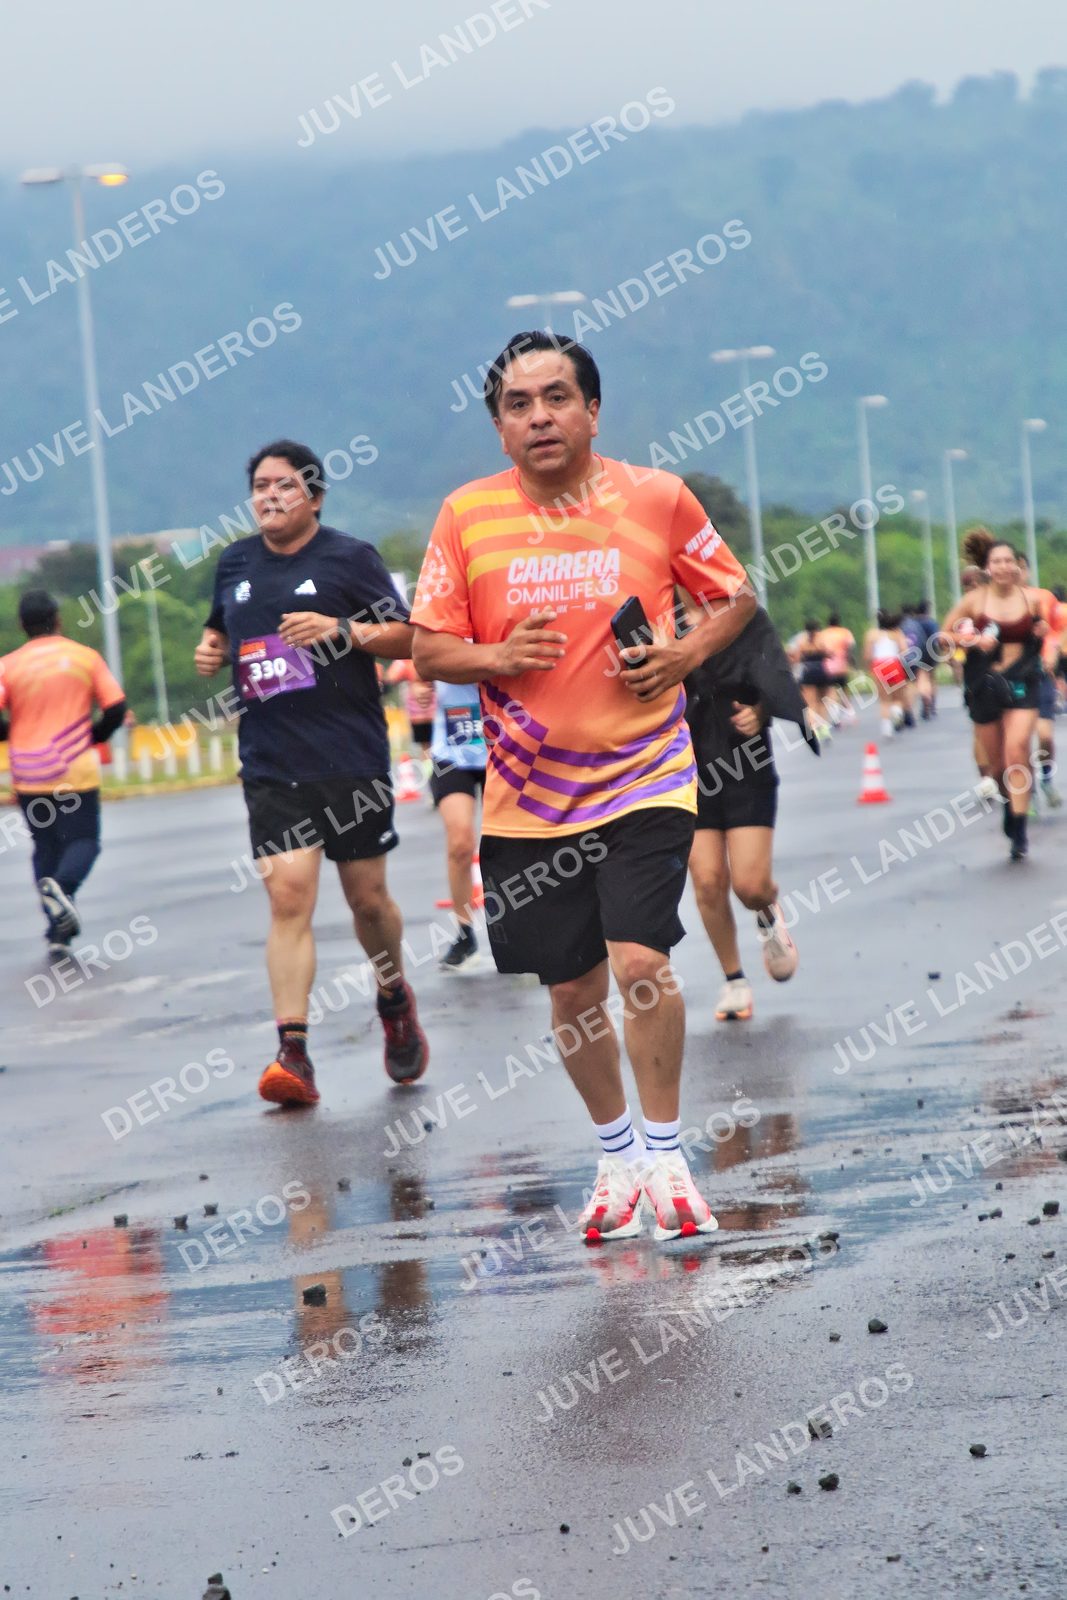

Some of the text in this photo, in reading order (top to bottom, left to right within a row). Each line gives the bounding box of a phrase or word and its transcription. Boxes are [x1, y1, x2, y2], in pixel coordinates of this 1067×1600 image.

[507, 548, 620, 584] CARRERA
[506, 580, 594, 605] OMNILIFE
[249, 657, 288, 682] 330
